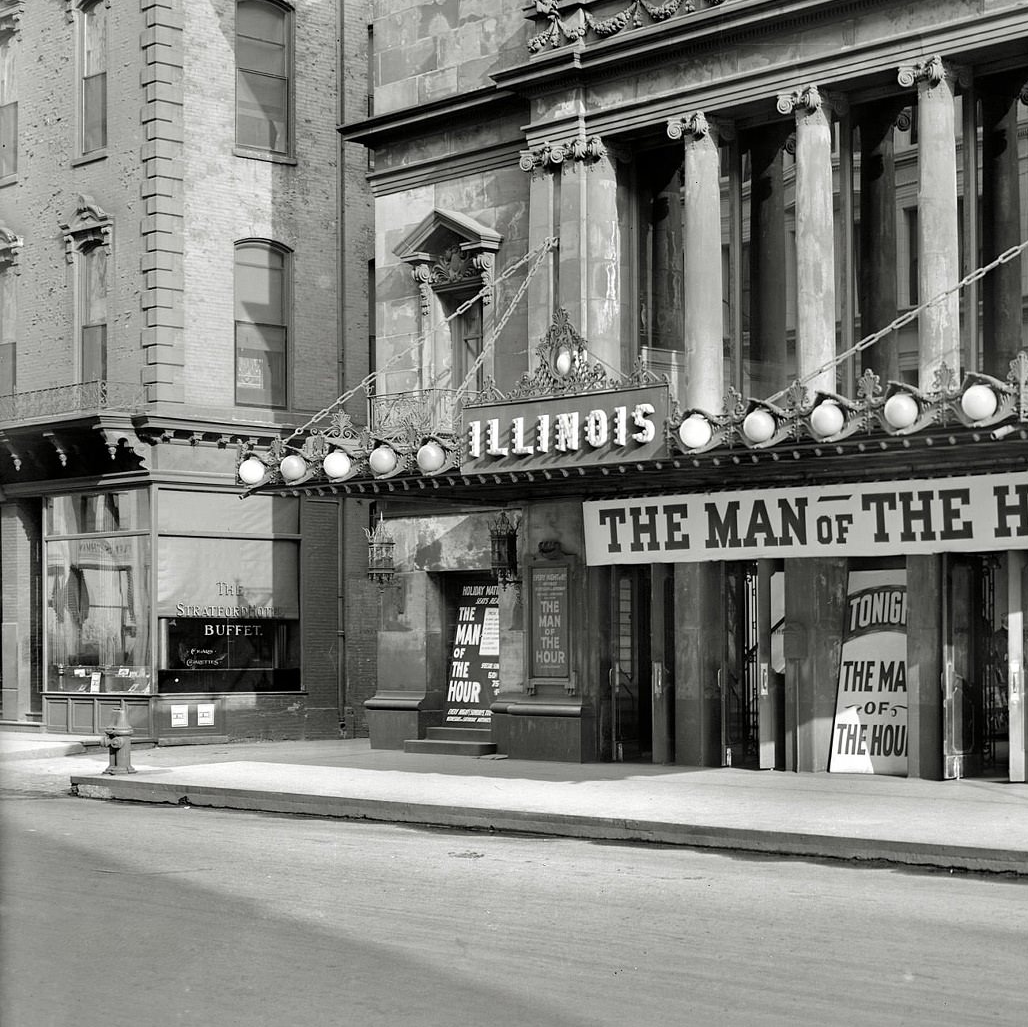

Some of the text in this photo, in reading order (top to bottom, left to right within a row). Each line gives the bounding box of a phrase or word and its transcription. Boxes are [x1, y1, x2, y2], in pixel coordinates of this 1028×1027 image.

[468, 403, 656, 458] ILLINOIS
[600, 503, 690, 554] THE
[704, 496, 809, 549] MAN
[816, 513, 854, 546] OF
[861, 487, 974, 544] THE
[216, 582, 245, 597] THE
[462, 585, 486, 596] HOLIDAY
[176, 603, 248, 618] STRATFORD
[459, 606, 477, 622] THE
[540, 600, 560, 613] THE
[850, 590, 908, 633] TONIG
[538, 614, 561, 628] MAN
[204, 624, 264, 636] BUFFET.
[455, 623, 482, 646] MAN
[544, 628, 555, 636] OF
[540, 636, 560, 649] THE
[453, 647, 466, 659] OF
[535, 650, 566, 664] HOUR
[452, 661, 470, 679] THE
[843, 660, 876, 693] THE
[447, 680, 482, 703] HOUR
[864, 701, 891, 715] OF
[837, 723, 908, 758] THE HOU
